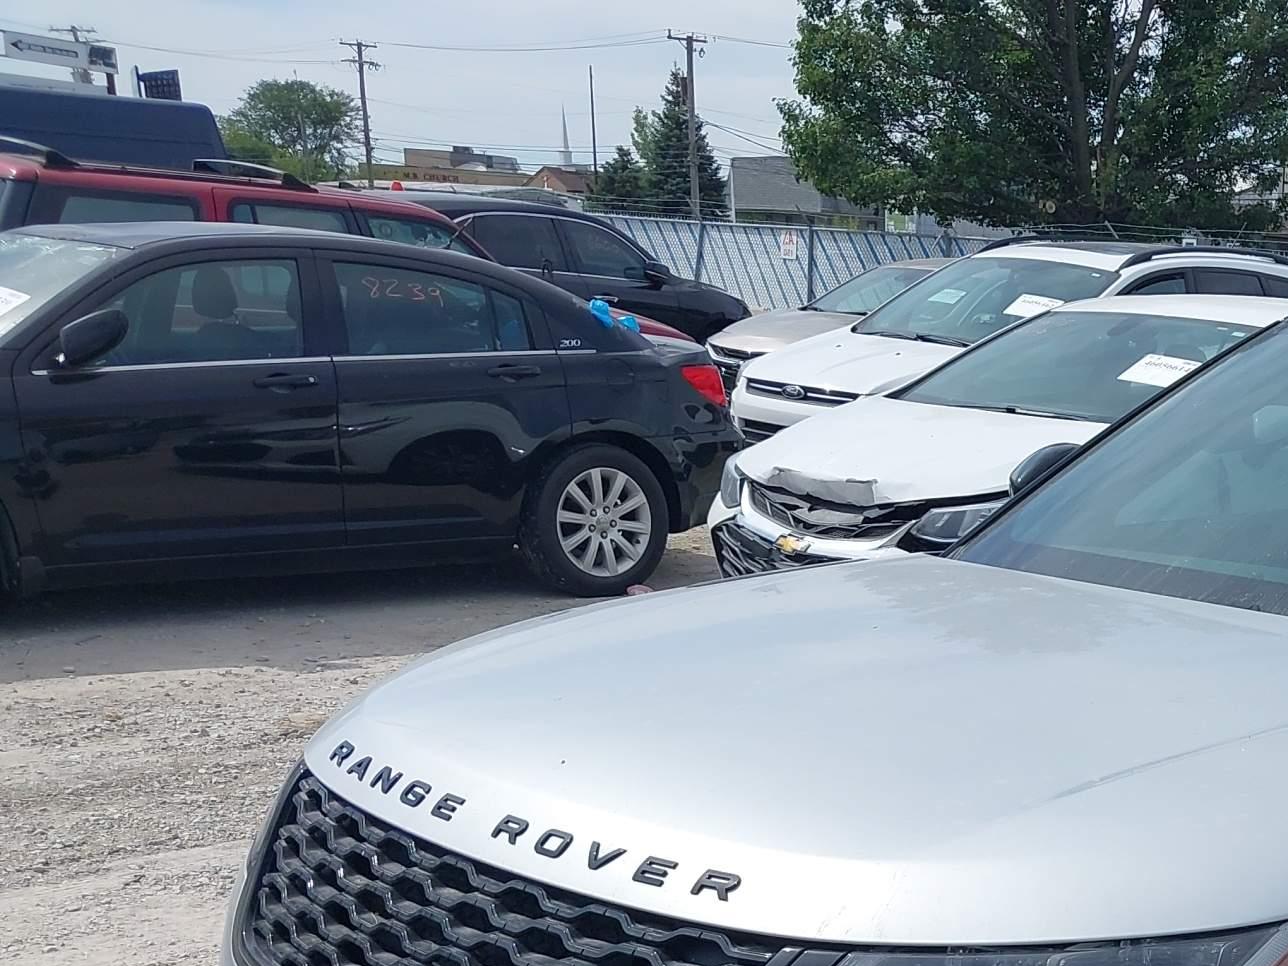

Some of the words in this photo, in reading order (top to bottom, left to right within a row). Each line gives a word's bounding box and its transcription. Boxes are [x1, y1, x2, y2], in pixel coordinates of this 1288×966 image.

[361, 277, 444, 307] 8239
[560, 338, 581, 348] 200
[329, 739, 466, 822] RANGE
[491, 814, 742, 901] ROVER
